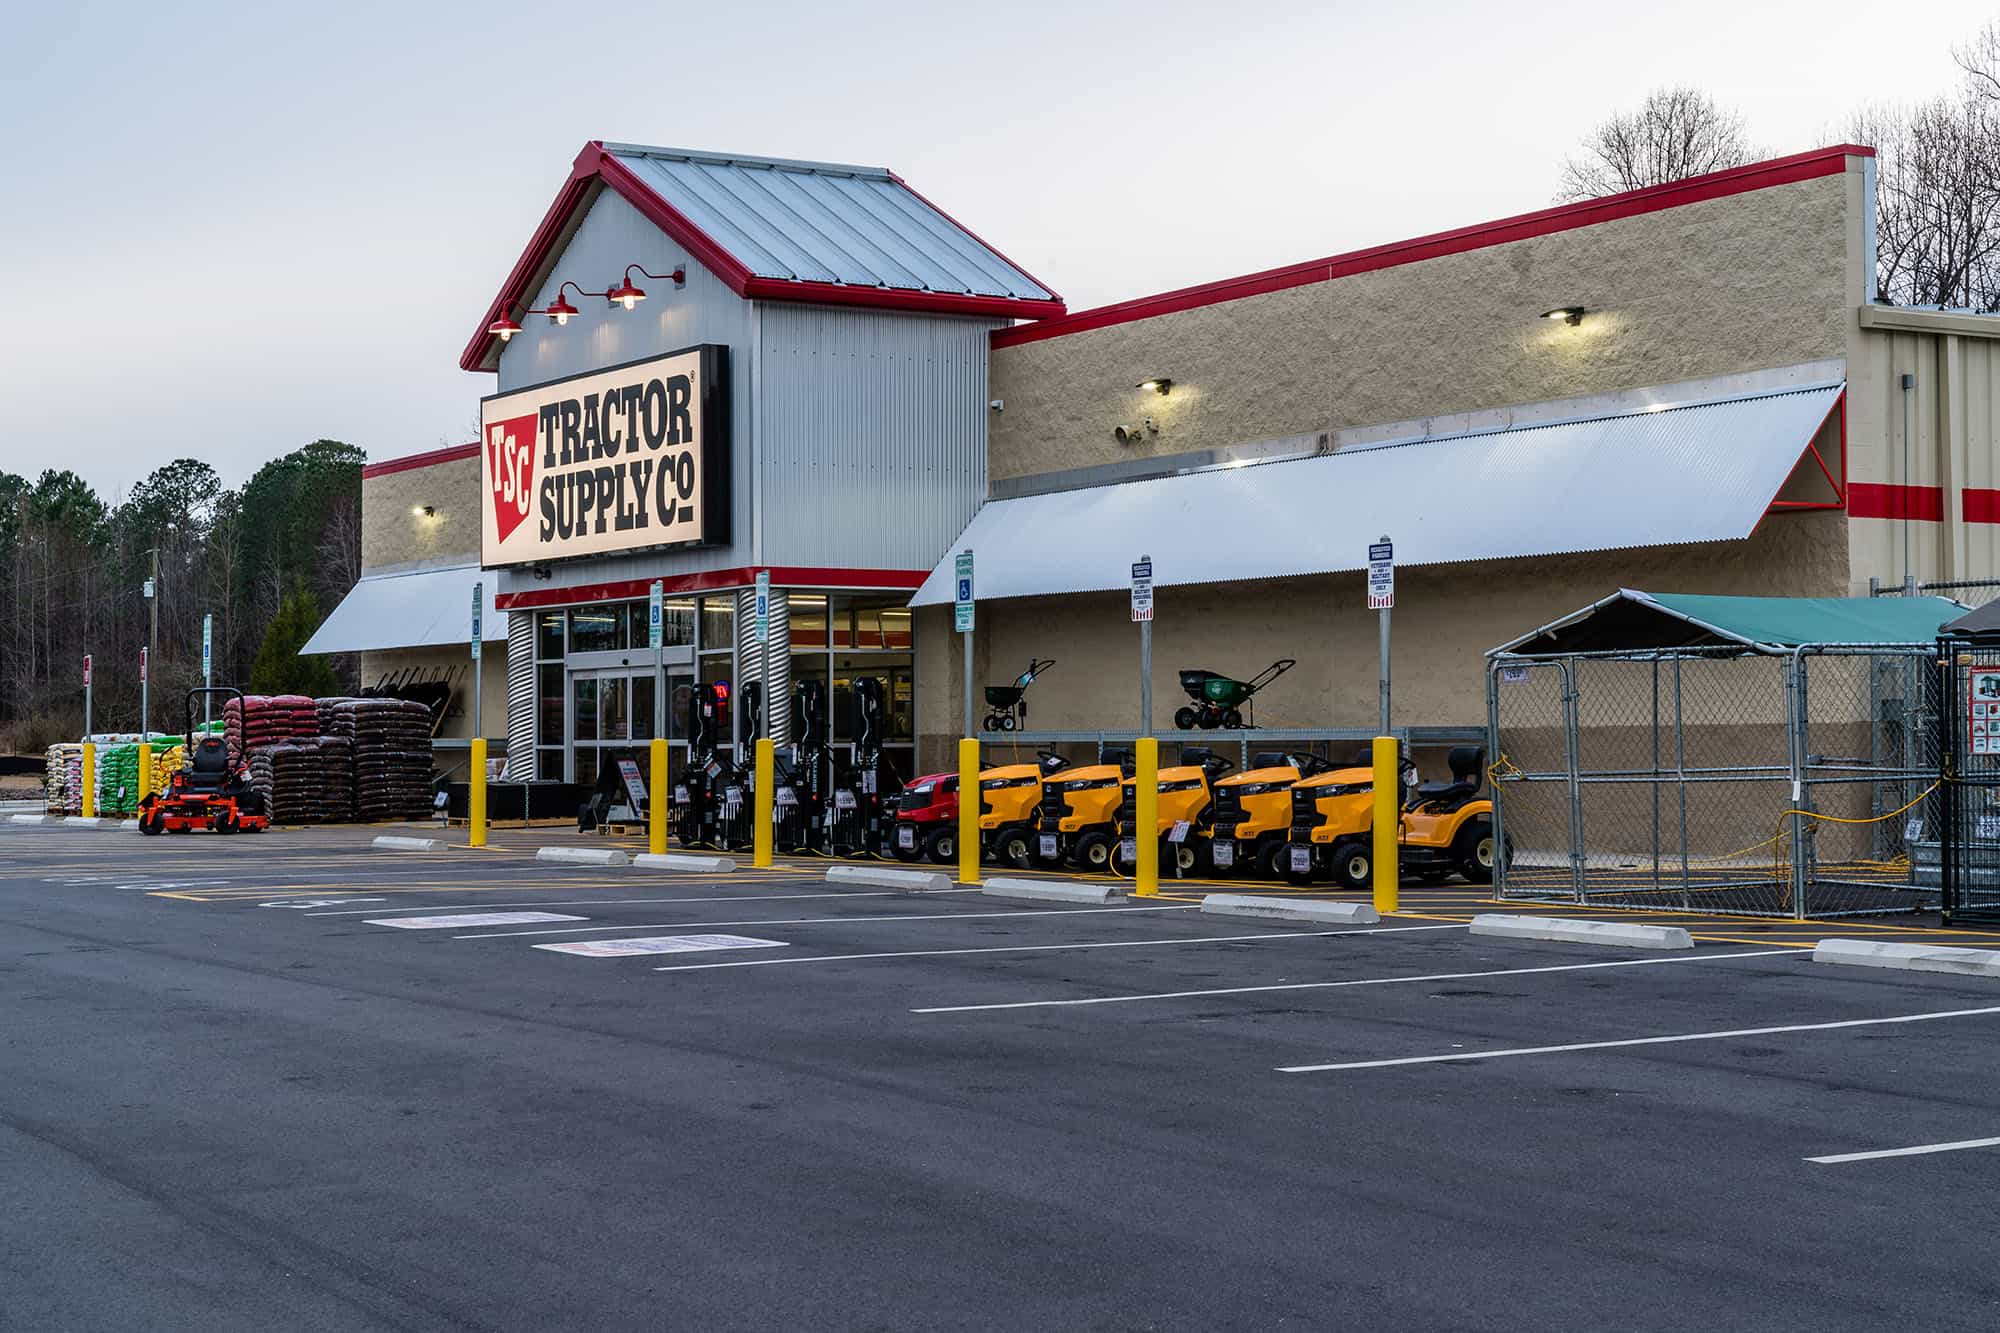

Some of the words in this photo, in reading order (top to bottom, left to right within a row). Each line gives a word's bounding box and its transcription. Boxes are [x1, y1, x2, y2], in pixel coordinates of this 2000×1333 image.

[540, 374, 692, 469] TRACTOR
[492, 425, 529, 515] TSC
[540, 459, 652, 543] SUPPLY
